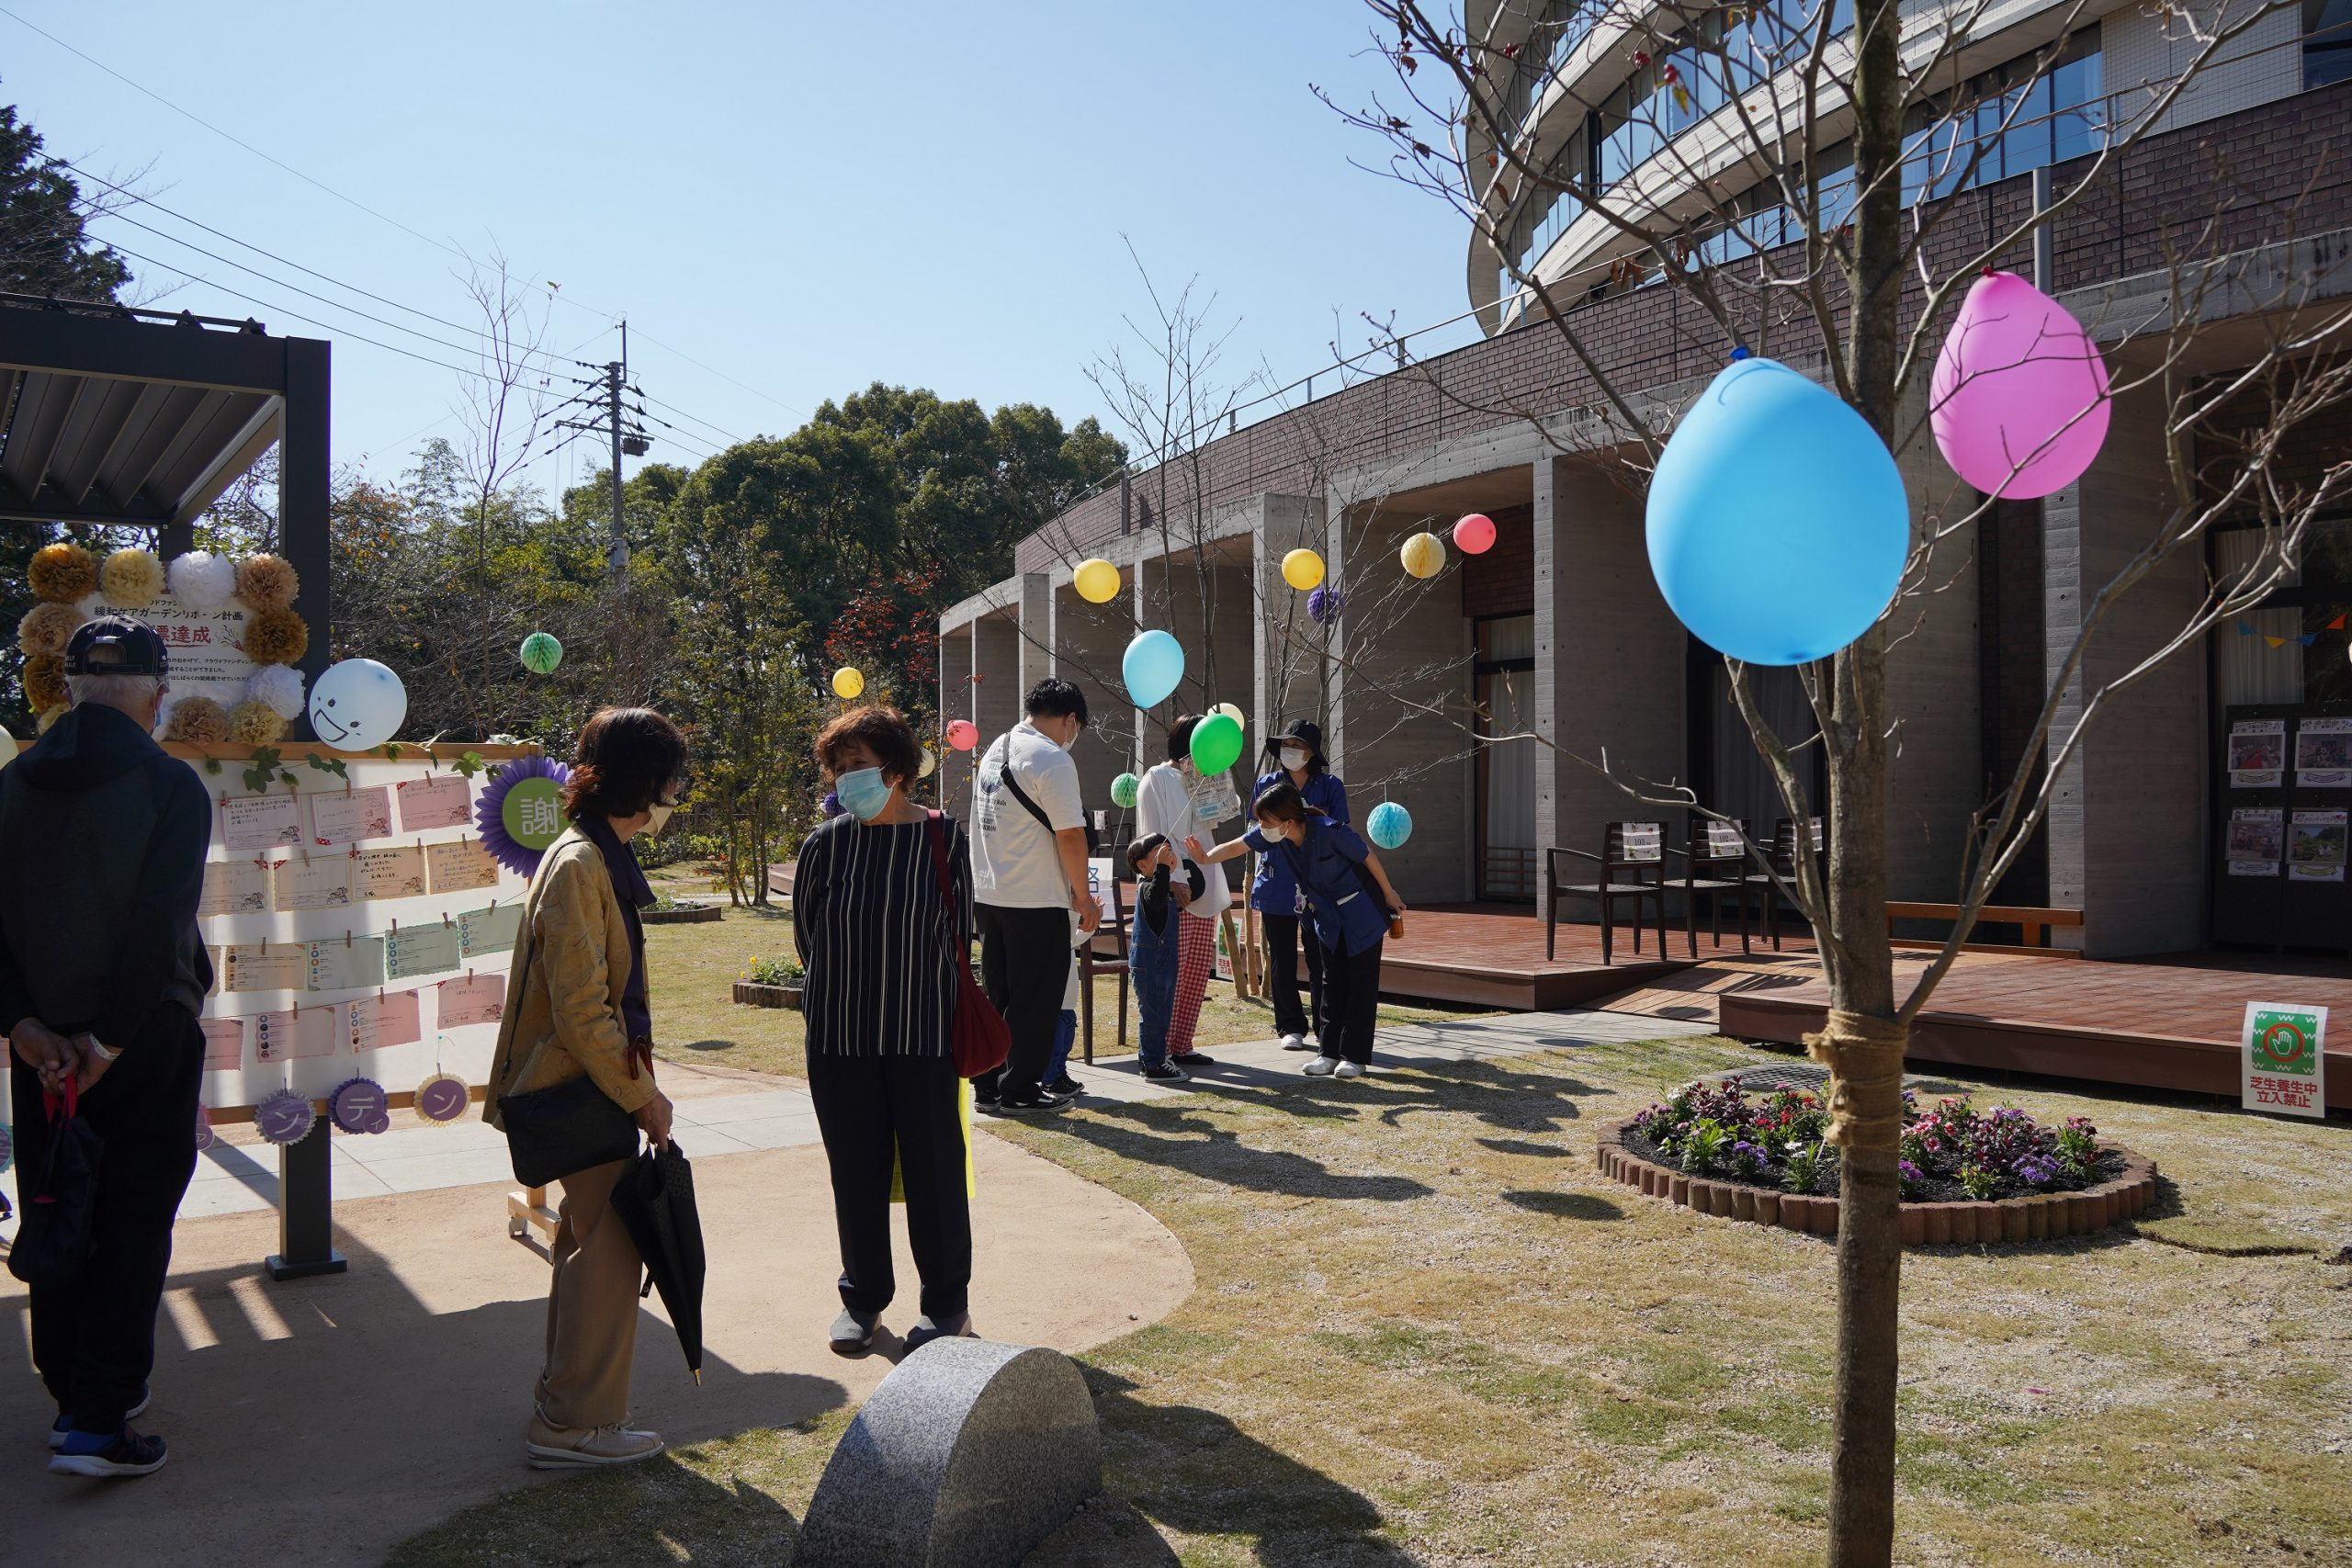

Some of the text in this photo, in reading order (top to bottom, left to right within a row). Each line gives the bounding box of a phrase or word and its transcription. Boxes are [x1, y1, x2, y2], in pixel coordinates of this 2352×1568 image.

[520, 796, 559, 835] 謝
[2249, 1076, 2318, 1096] 芝生養生中
[2256, 1090, 2312, 1108] 立入禁止
